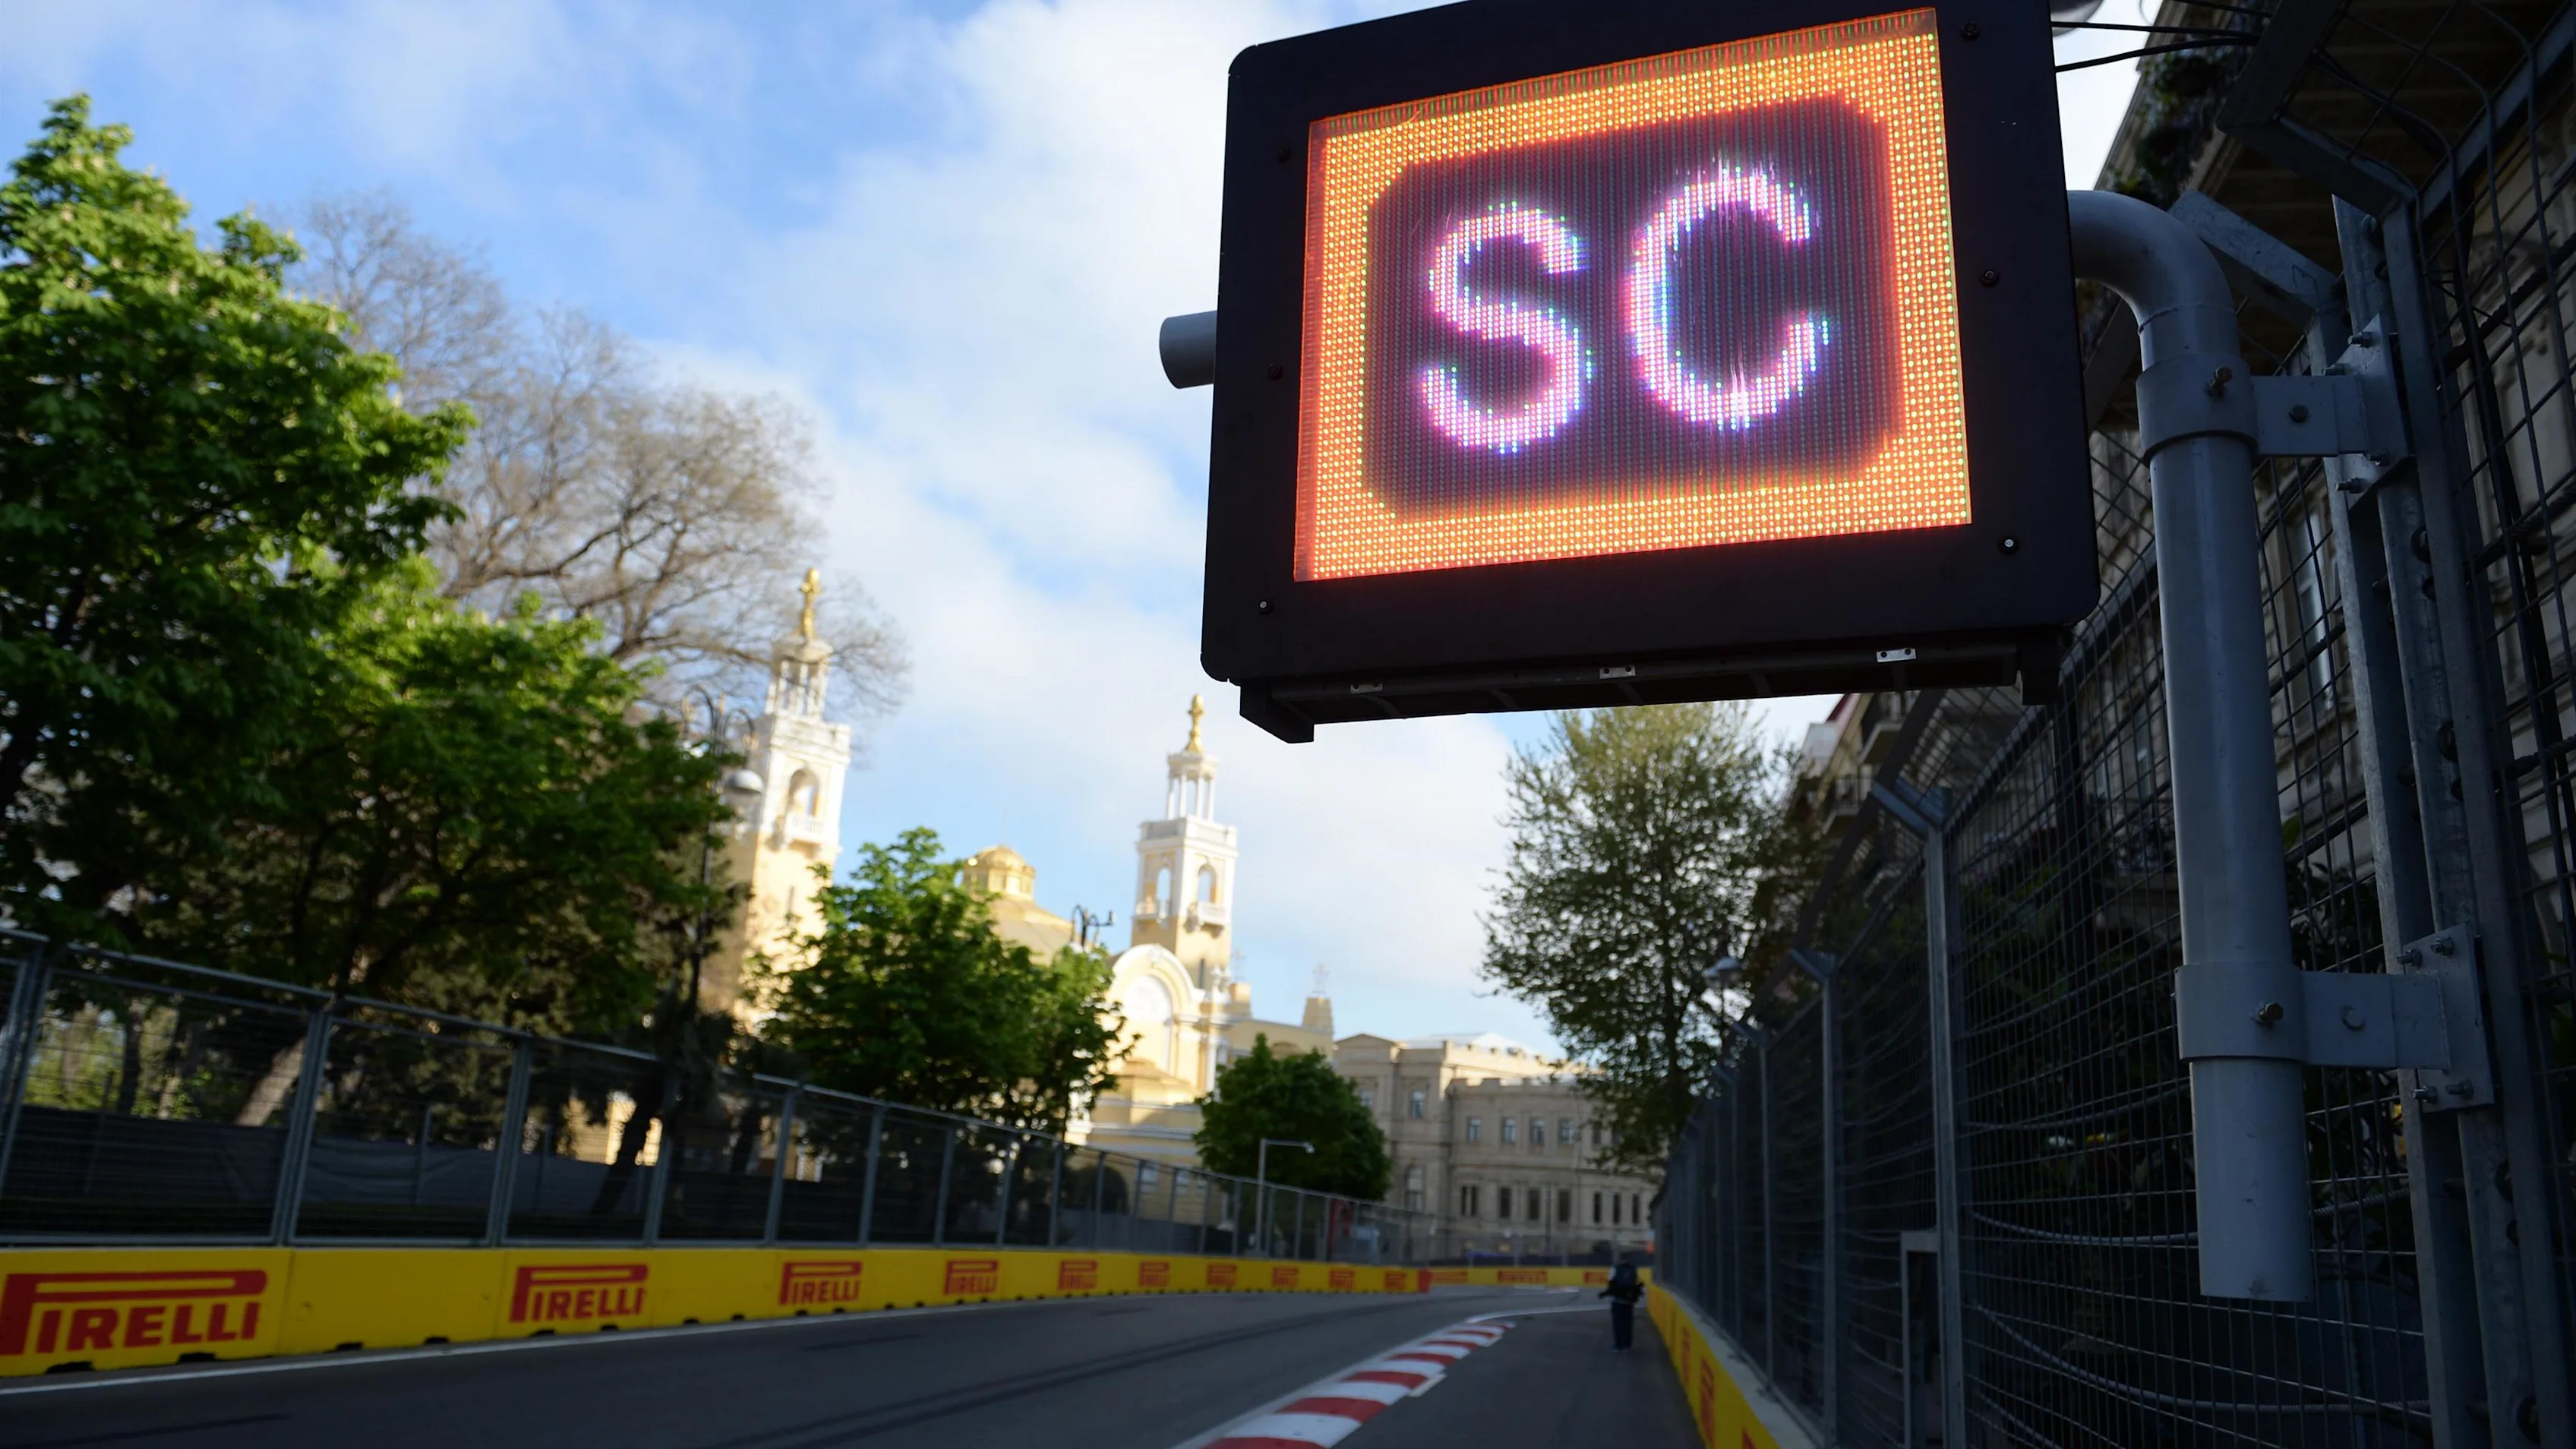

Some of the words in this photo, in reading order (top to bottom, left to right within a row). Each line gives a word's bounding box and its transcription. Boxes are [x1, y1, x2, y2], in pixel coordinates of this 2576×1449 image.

[1420, 161, 1831, 454] SC
[510, 1264, 649, 1323] PIRELLI
[778, 1261, 863, 1305] PIRELLI
[943, 1260, 999, 1295] PIRELLI
[0, 1270, 267, 1356] PIRELLI
